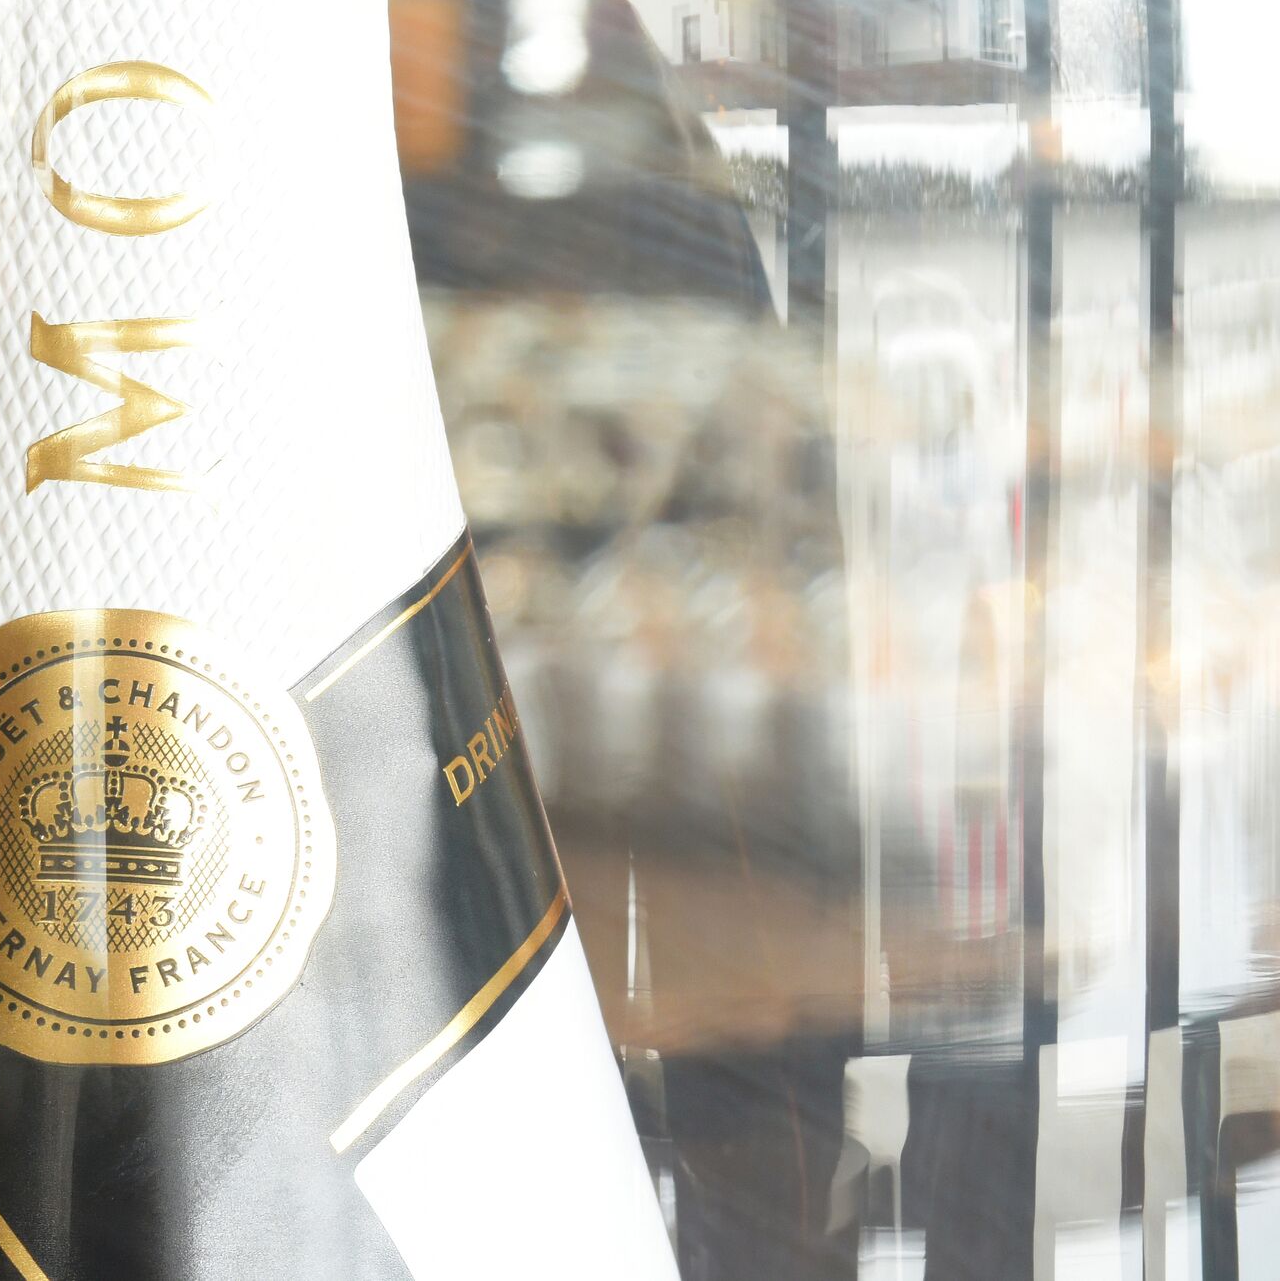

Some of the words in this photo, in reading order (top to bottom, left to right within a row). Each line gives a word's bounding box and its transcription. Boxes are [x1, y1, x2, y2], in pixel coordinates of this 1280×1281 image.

[57, 685, 83, 711] &
[97, 677, 267, 805] CHANDON
[38, 889, 176, 927] 1743
[130, 876, 267, 995] FRANCE
